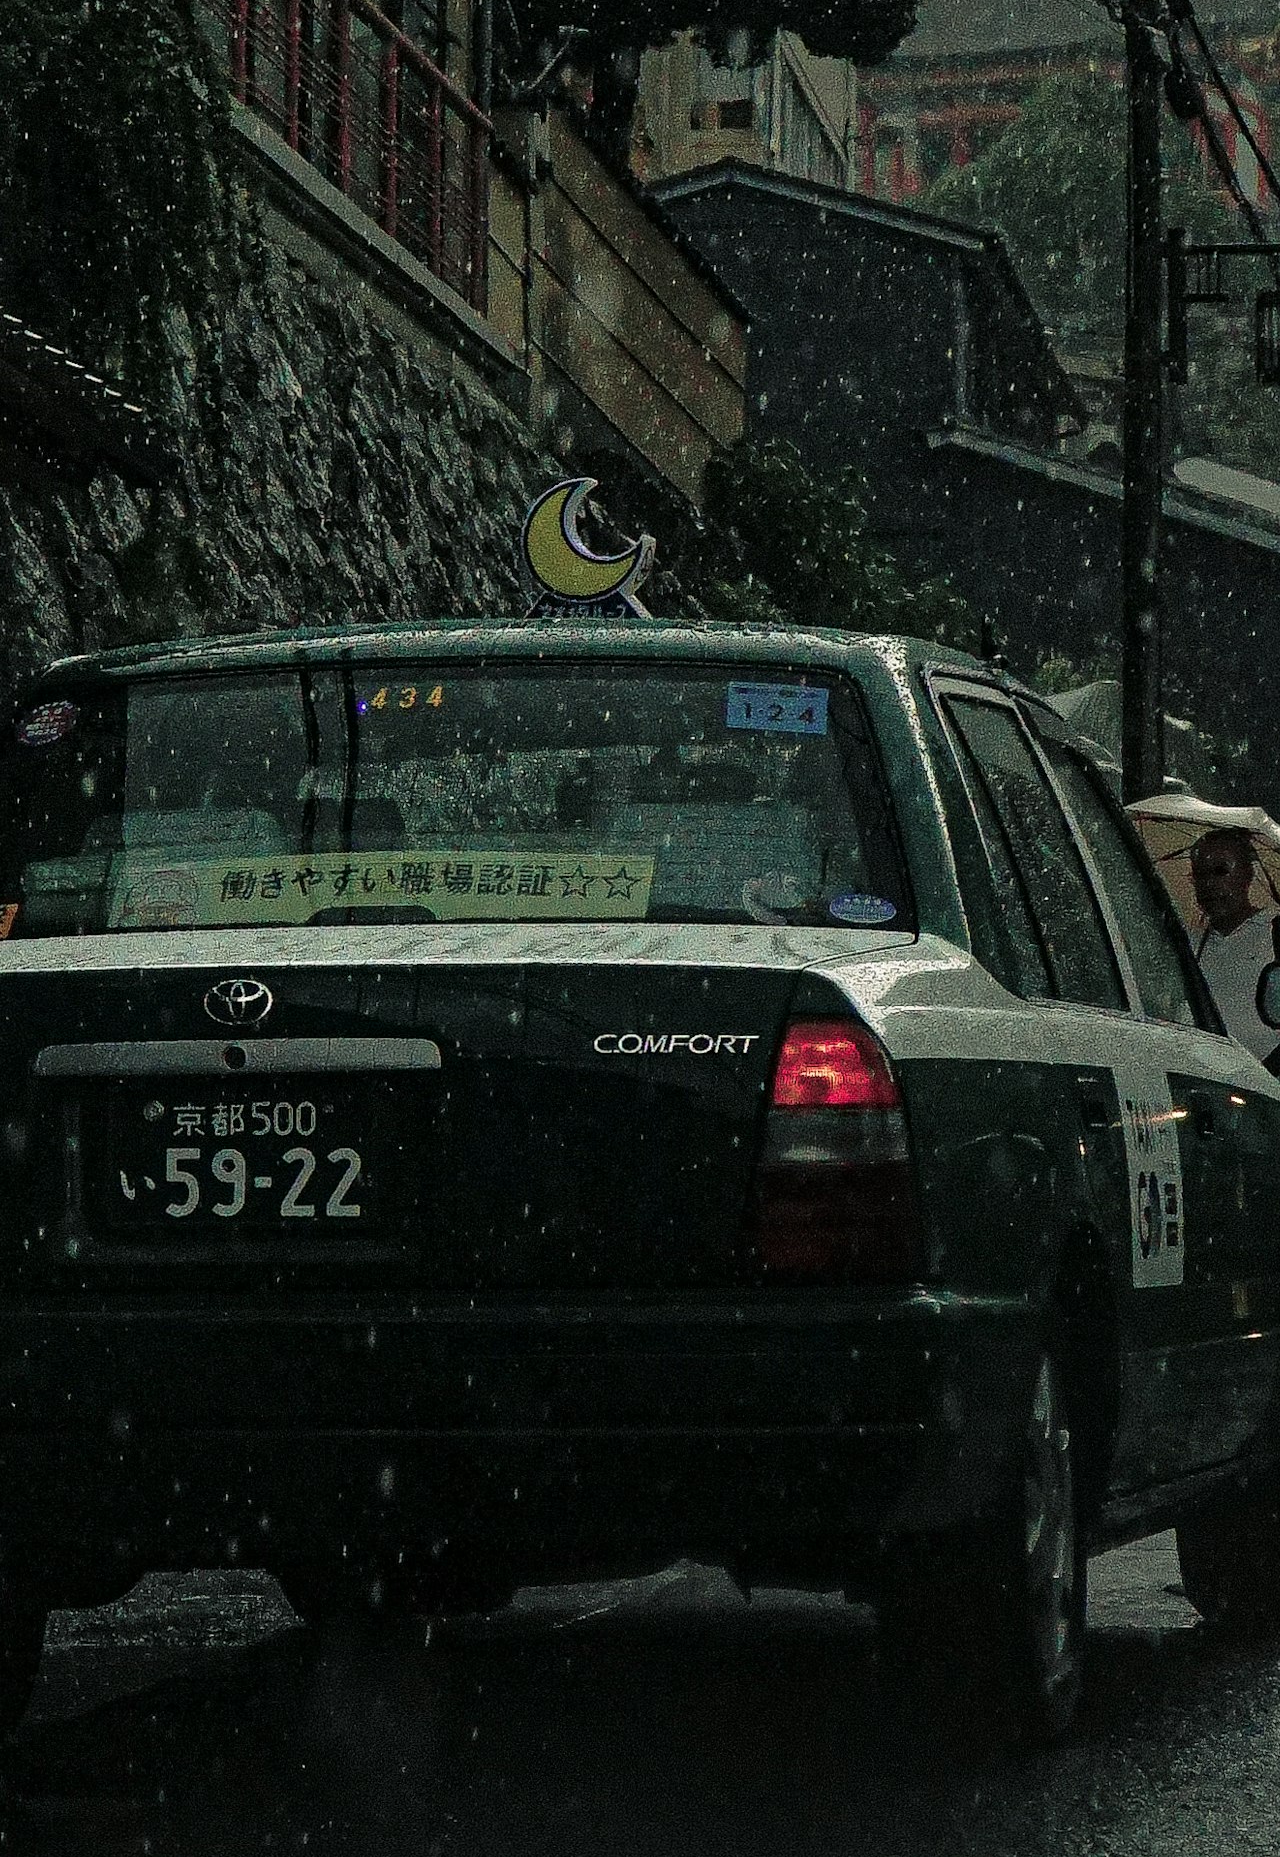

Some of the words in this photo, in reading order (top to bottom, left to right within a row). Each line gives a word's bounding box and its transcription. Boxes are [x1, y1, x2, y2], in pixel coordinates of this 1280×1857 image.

[593, 1032, 761, 1055] COMFORT
[119, 1170, 156, 1201] い
[165, 1147, 362, 1218] 59-22
